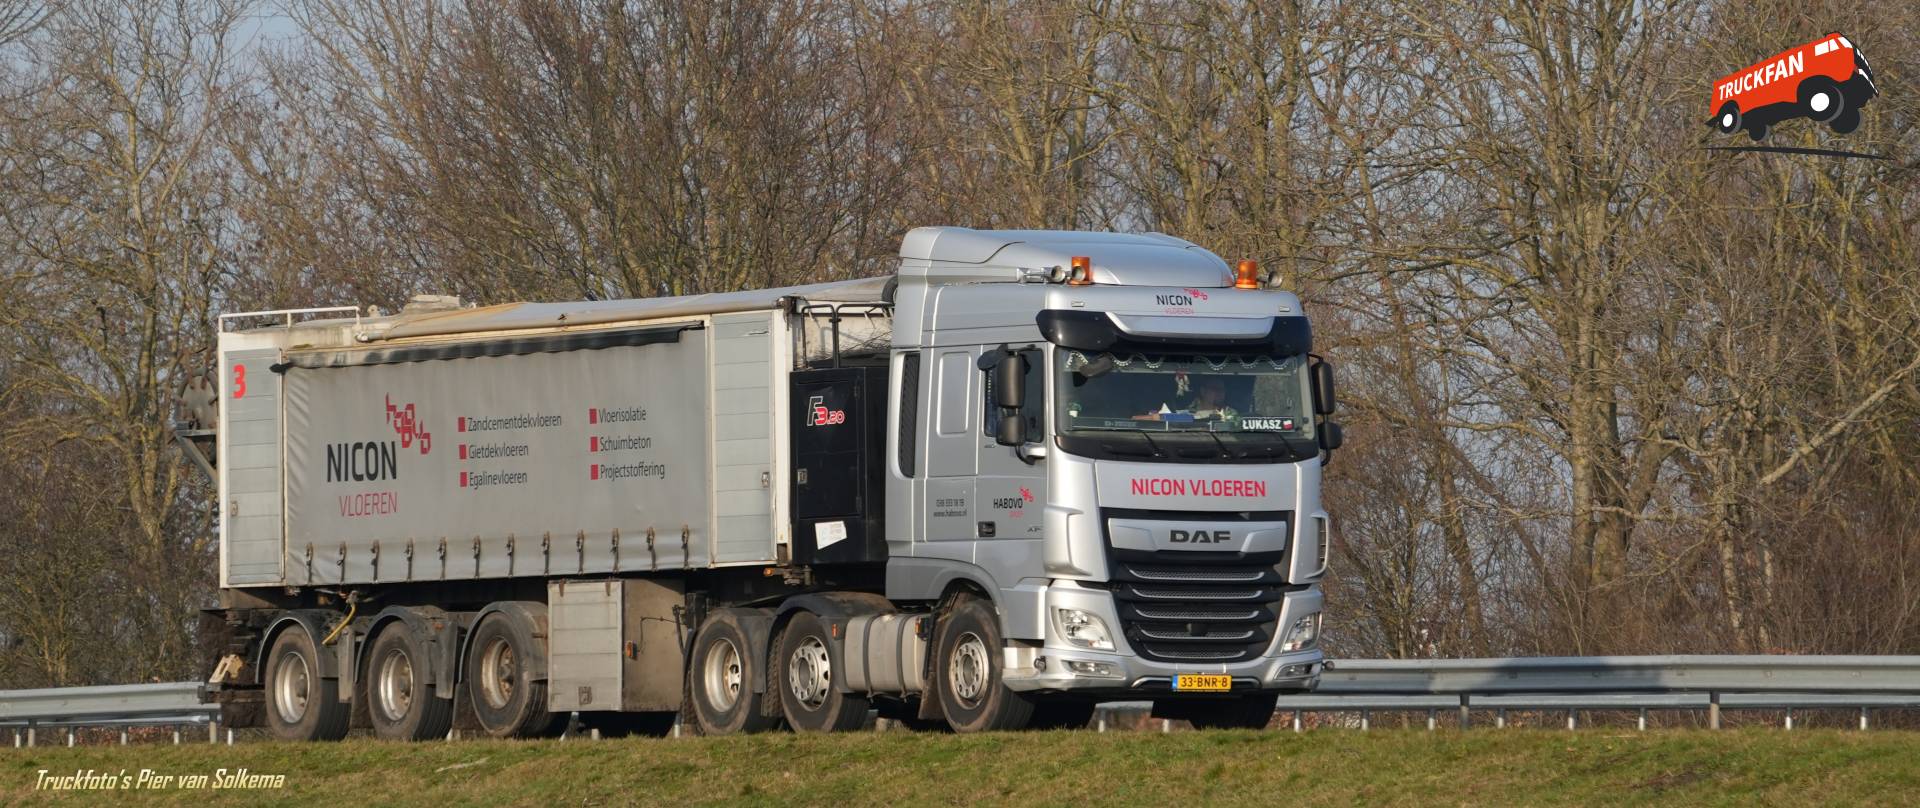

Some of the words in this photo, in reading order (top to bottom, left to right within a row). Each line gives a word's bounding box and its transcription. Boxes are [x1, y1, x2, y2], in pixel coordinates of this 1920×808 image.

[1156, 294, 1193, 306] NICON
[232, 364, 247, 399] 3
[467, 412, 563, 432] Zandcementdekvloeren
[599, 406, 647, 423] Vloerisolatie
[1242, 418, 1282, 430] ŁUKASZ
[468, 443, 529, 460] Gietdekvloeren
[600, 435, 652, 452] Schuimbeton
[326, 441, 398, 483] NICON
[469, 470, 528, 488] Egalinevloeren
[600, 462, 665, 482] Projectstoffering
[1131, 478, 1185, 496] NICON
[1189, 479, 1266, 497] VLOEREN
[339, 491, 398, 517] VLOEREN
[993, 498, 1024, 509] HABOVO
[1170, 530, 1232, 544] DAF
[1181, 675, 1229, 689] 33-BNR-8
